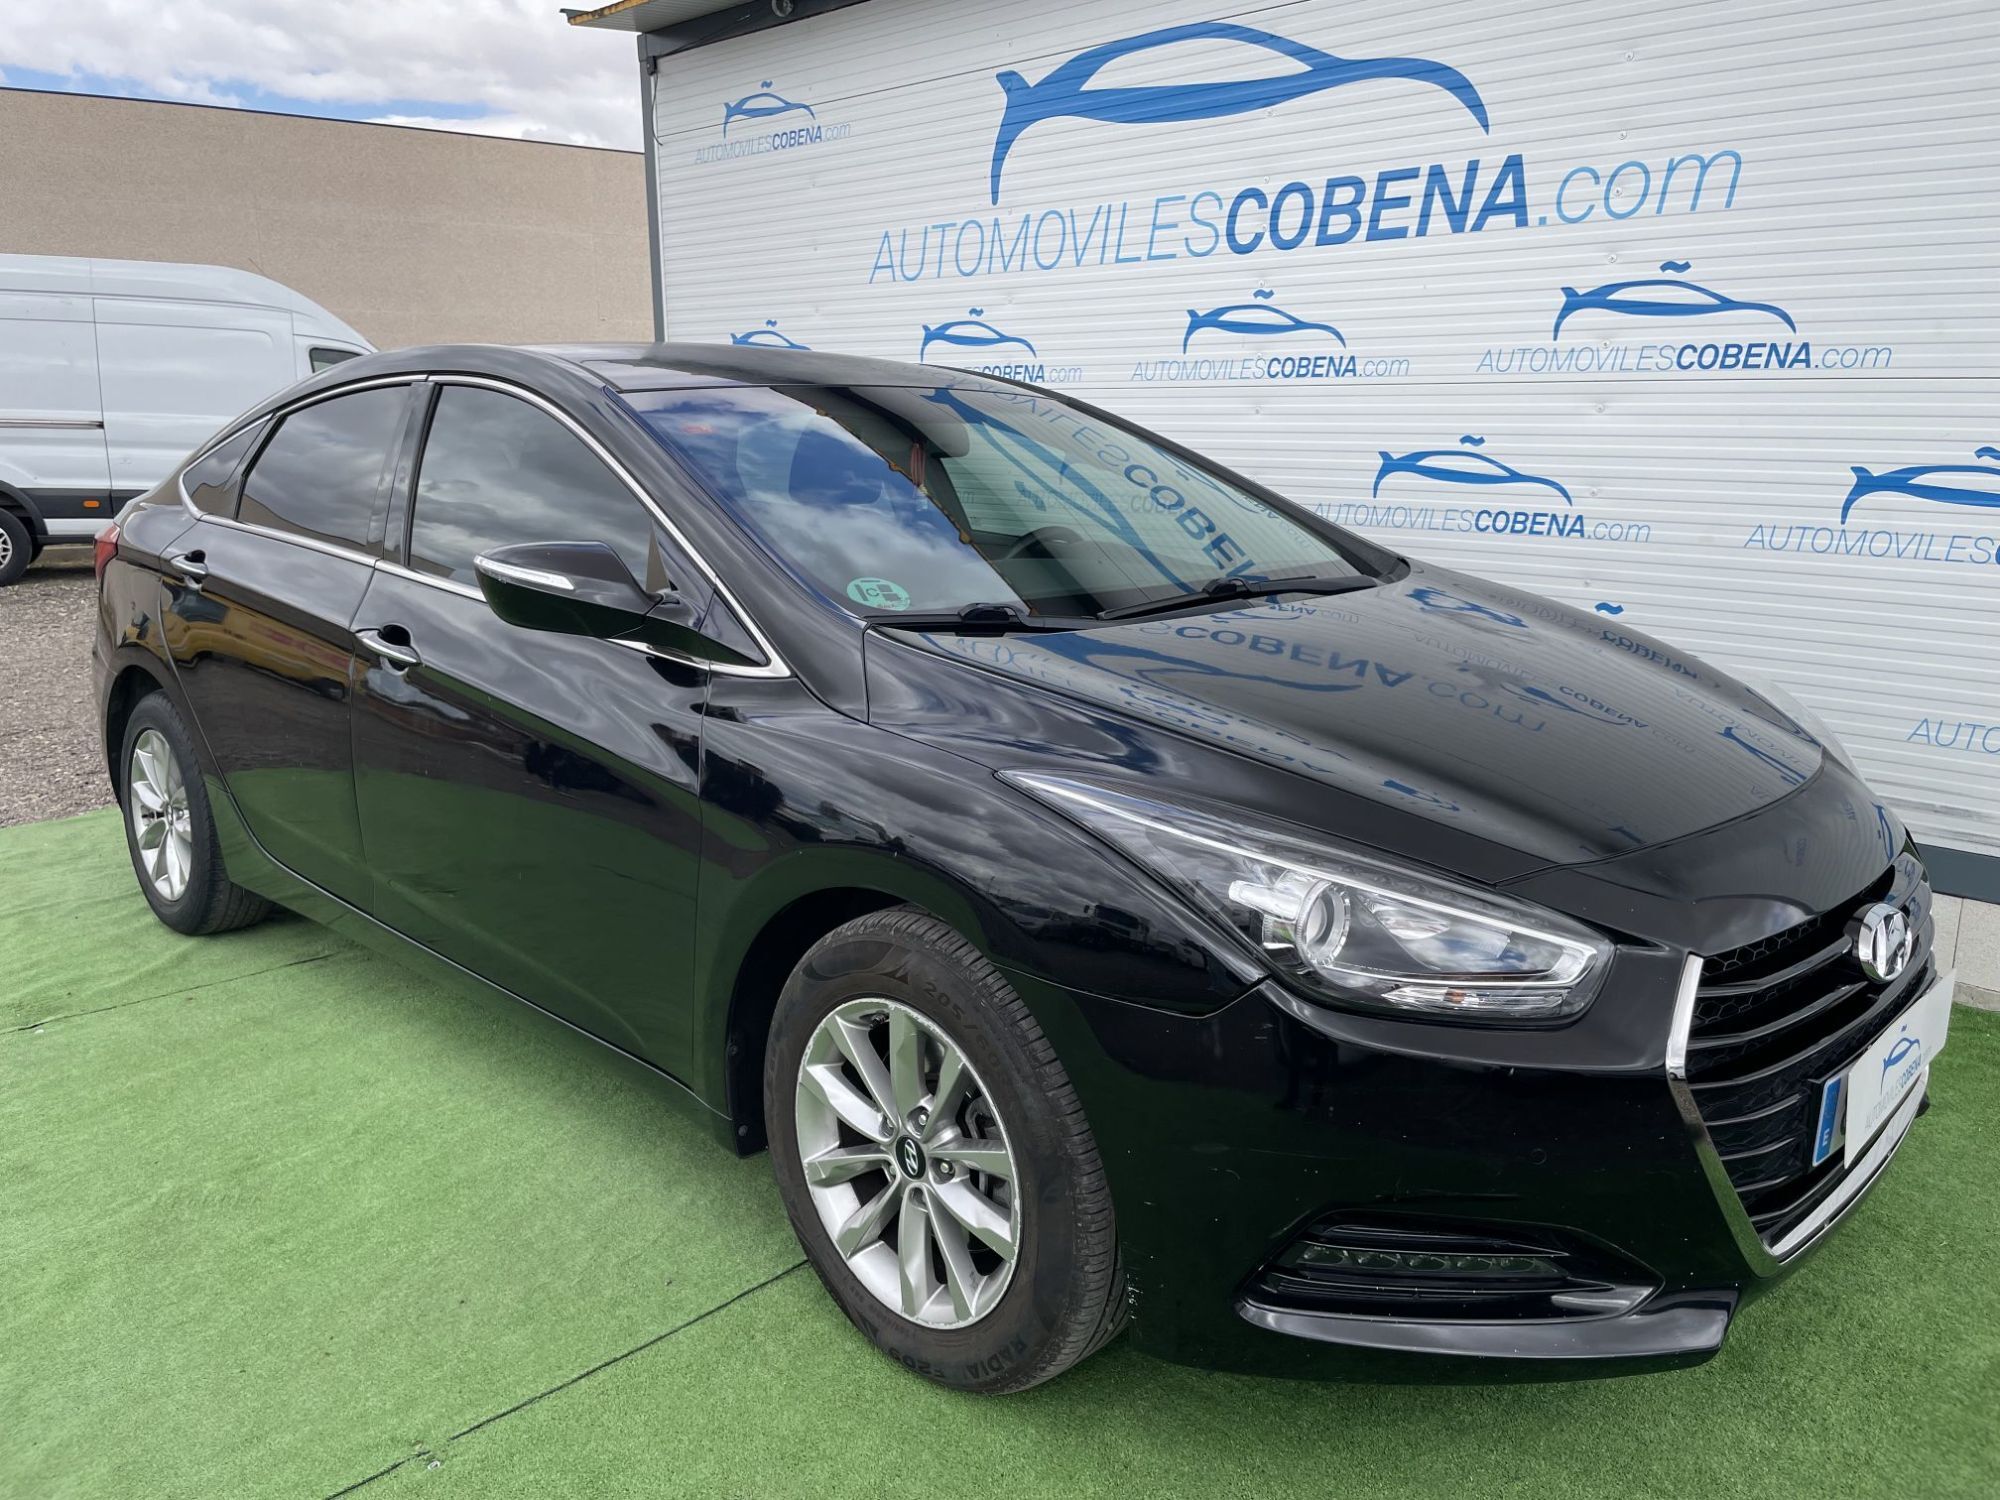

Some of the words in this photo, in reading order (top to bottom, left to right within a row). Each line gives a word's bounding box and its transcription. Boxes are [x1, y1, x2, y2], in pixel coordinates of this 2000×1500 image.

[694, 123, 851, 164] AUTOMOVILESCOBENA.com
[868, 149, 1742, 284] AUTOMOVILESCOBENA.com
[1131, 355, 1410, 382] AUTOMOVILESCOBENA.com
[1476, 342, 1892, 374] AUTOMOVILESCOBENA.com
[1313, 503, 1651, 543] AUTOMOVILESCOBENA.com
[1744, 523, 2000, 566] AUTOMOVILES
